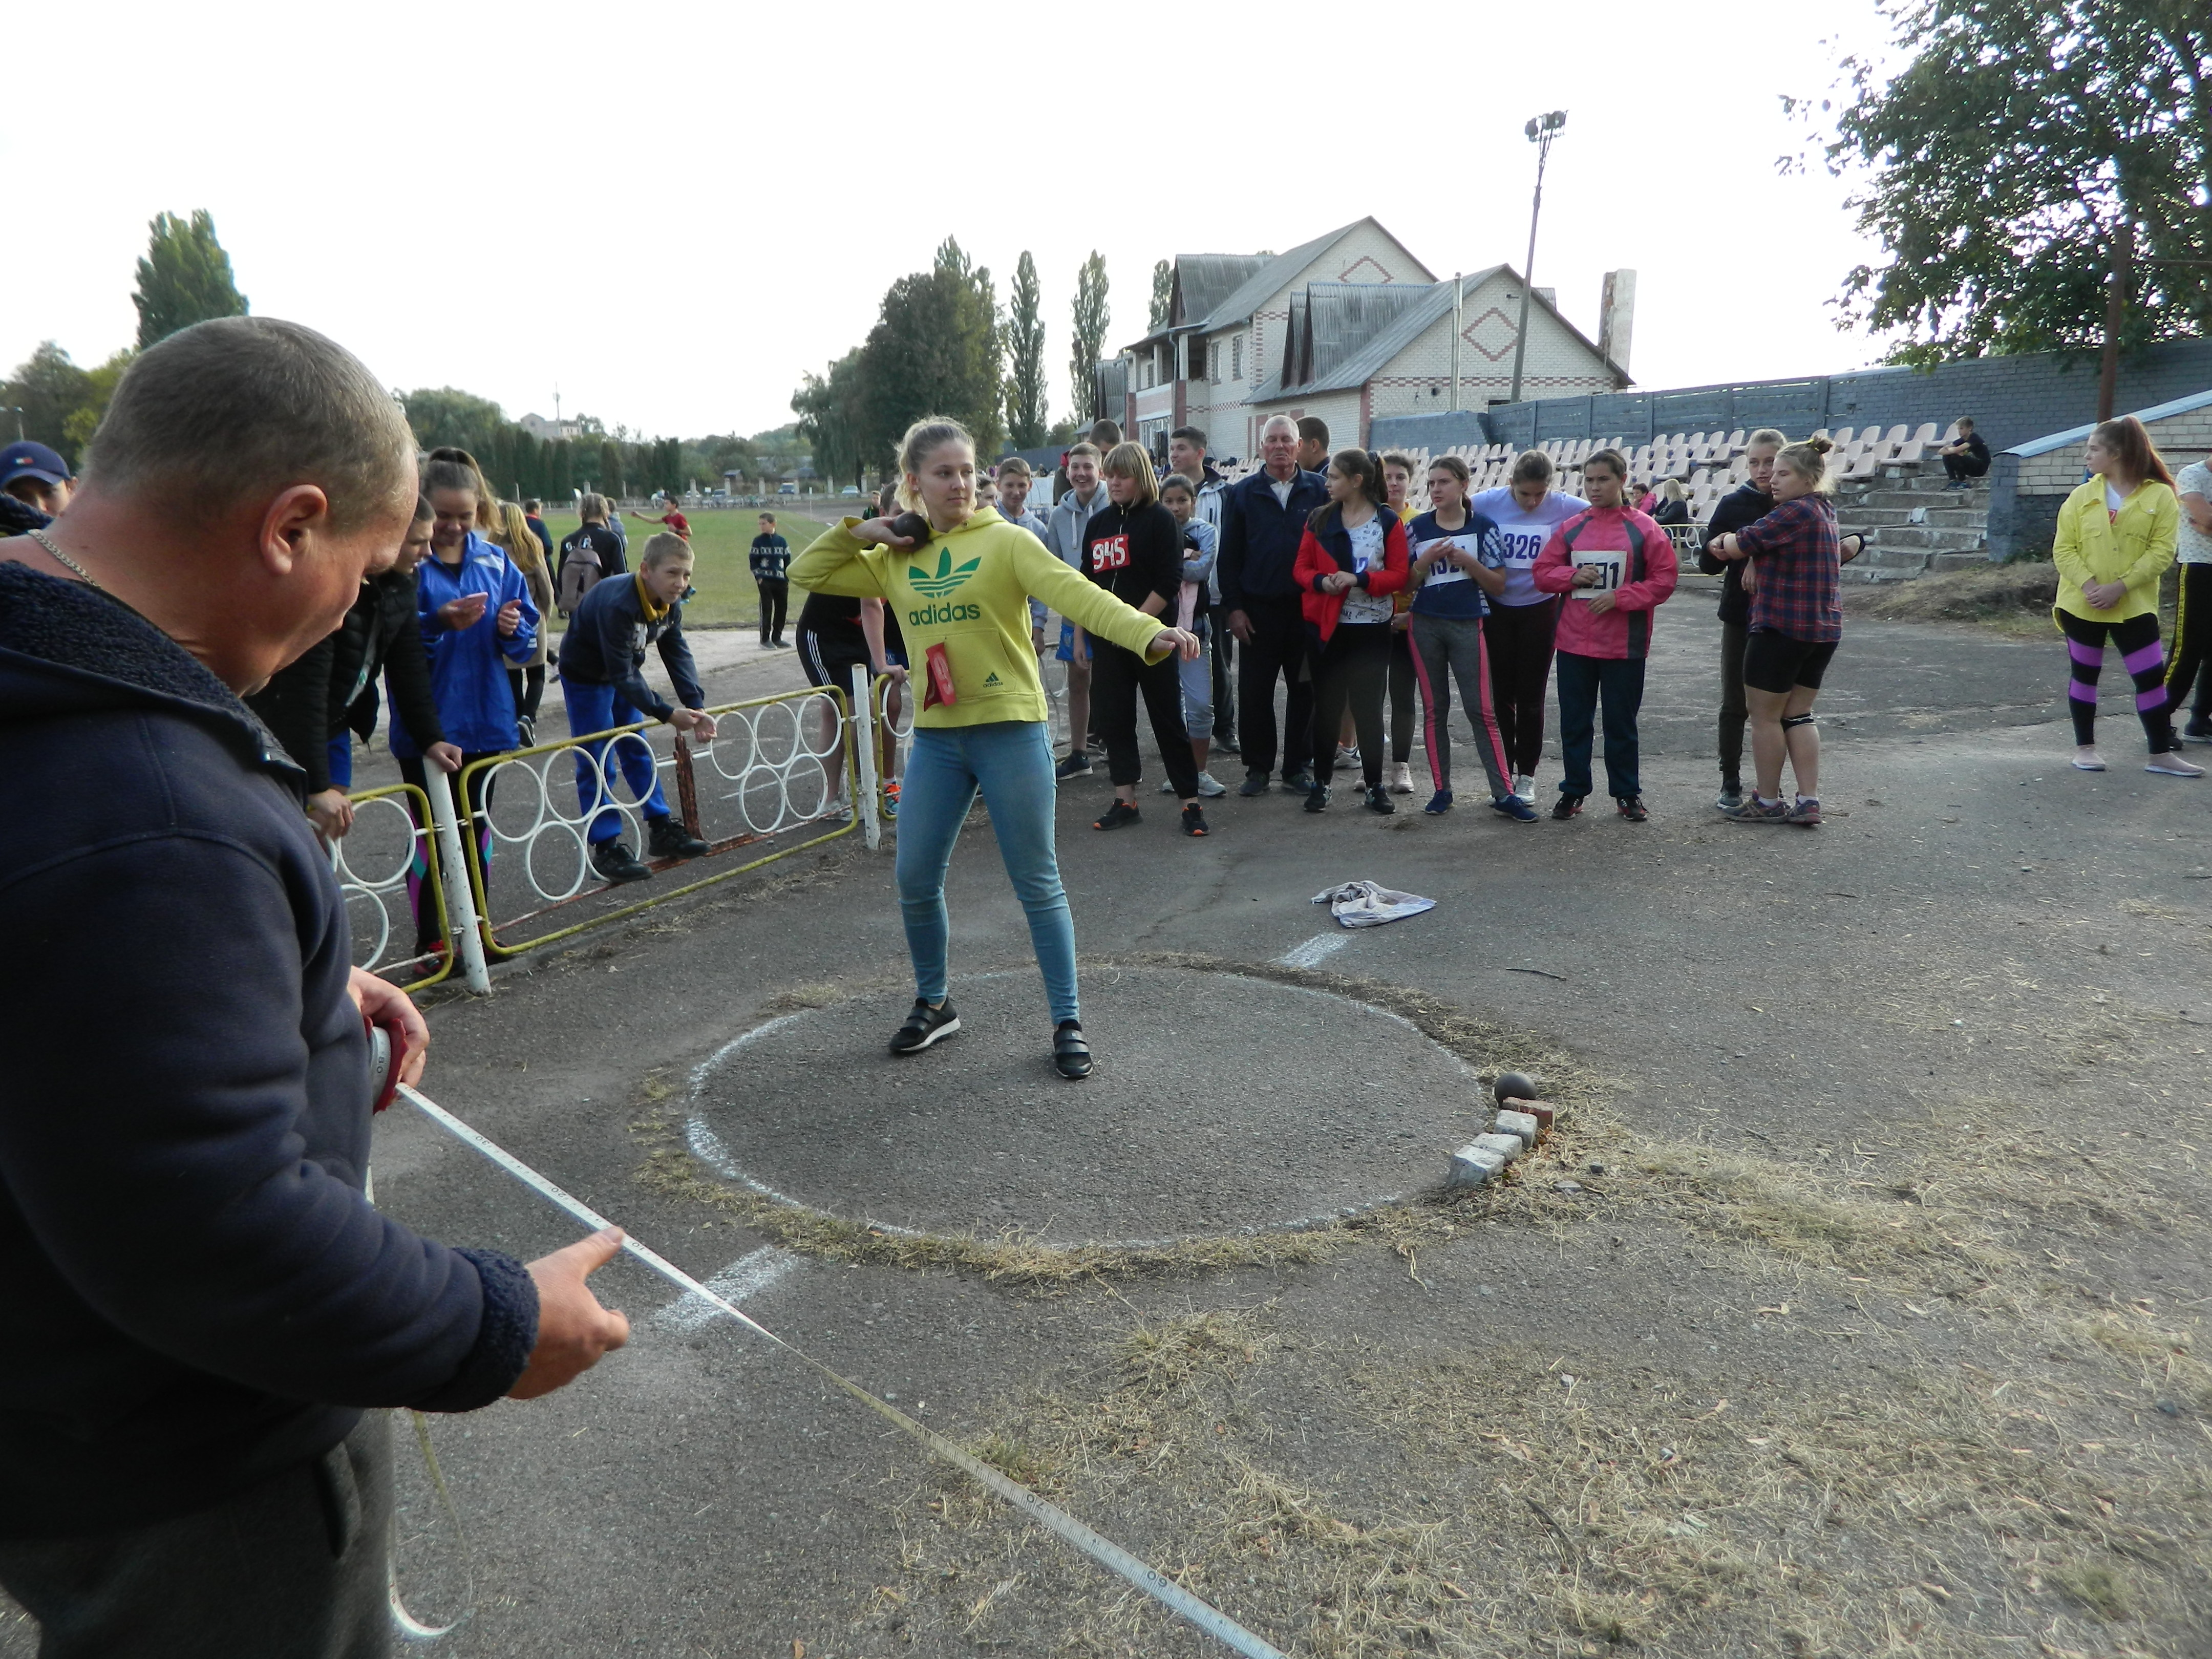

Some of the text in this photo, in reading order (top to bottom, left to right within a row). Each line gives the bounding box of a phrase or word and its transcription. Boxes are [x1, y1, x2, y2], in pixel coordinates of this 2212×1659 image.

[1093, 537, 1125, 570] 945
[1503, 533, 1541, 559] 326
[909, 602, 981, 626] adidas
[551, 1187, 567, 1198] 20
[1026, 1494, 1044, 1511] 70
[1147, 1570, 1168, 1587] 60
